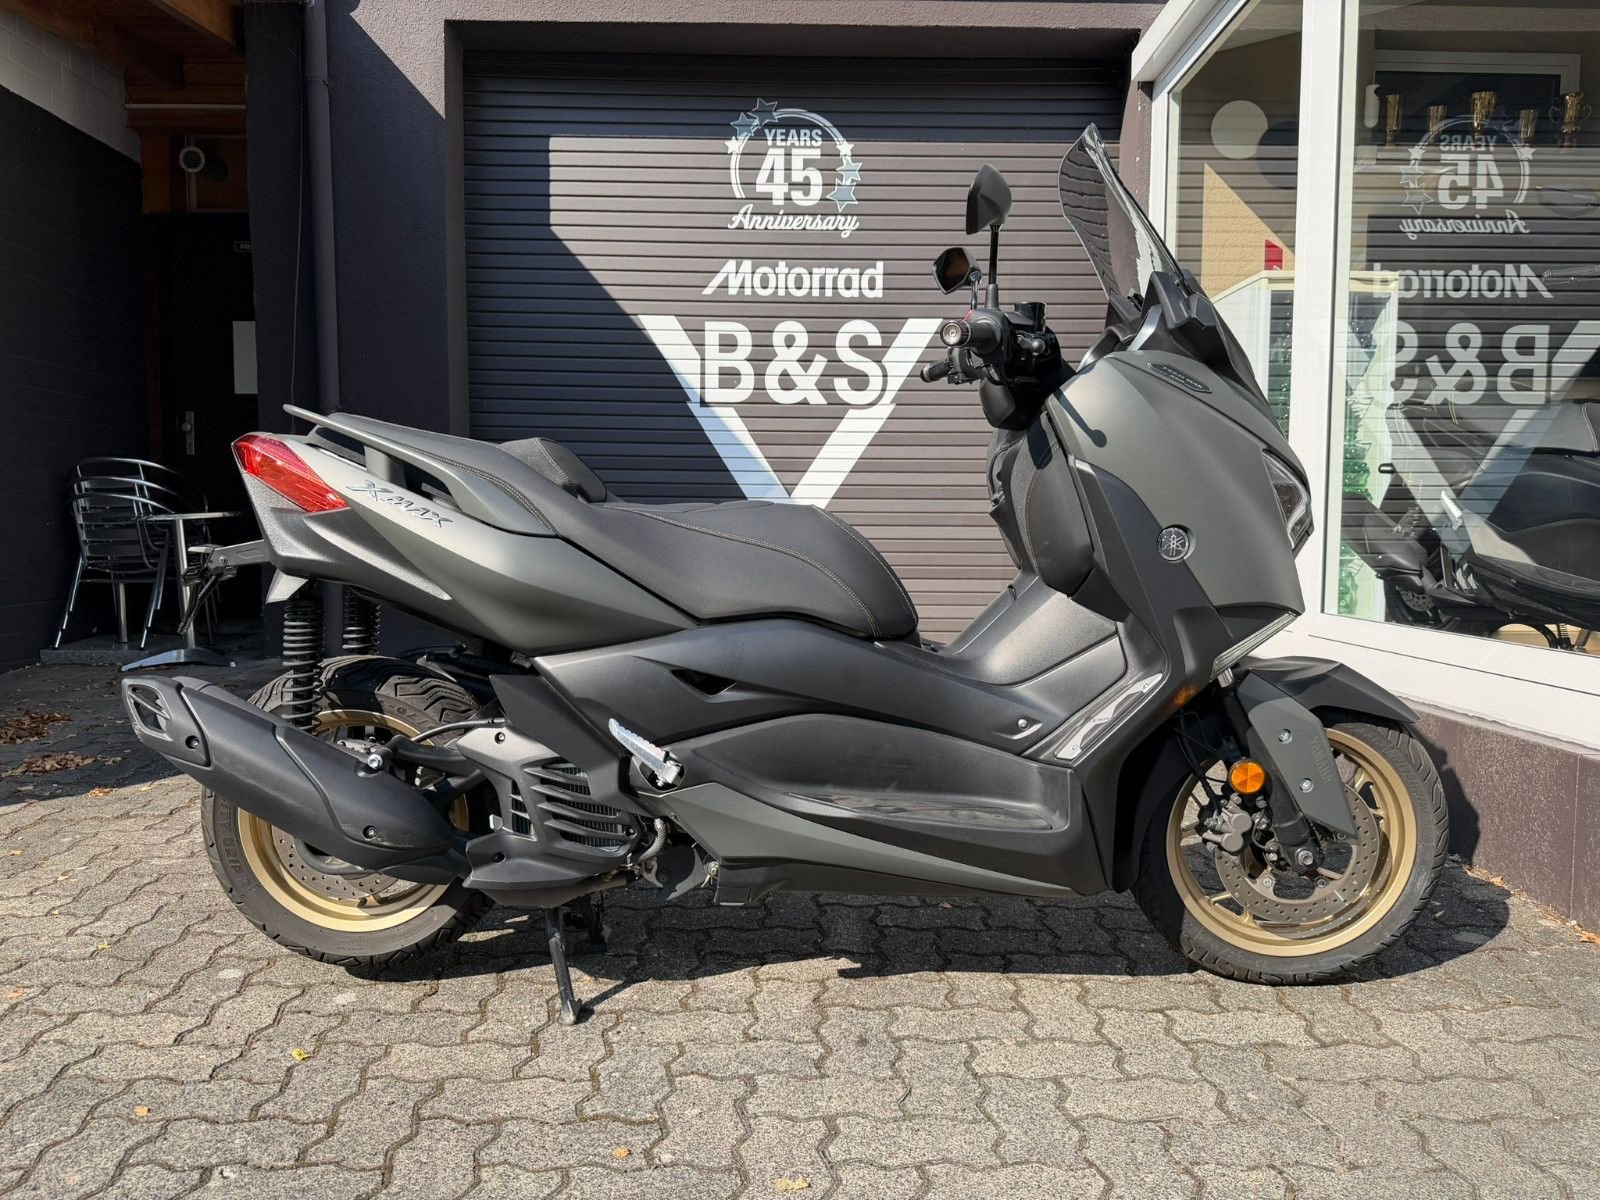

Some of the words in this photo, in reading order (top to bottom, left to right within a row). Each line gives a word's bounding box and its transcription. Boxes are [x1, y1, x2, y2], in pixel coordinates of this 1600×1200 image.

[764, 128, 823, 147] YEARS
[755, 147, 823, 207] 45
[727, 203, 860, 238] Anniversary
[701, 259, 884, 298] Motorrad
[705, 320, 883, 405] B&S
